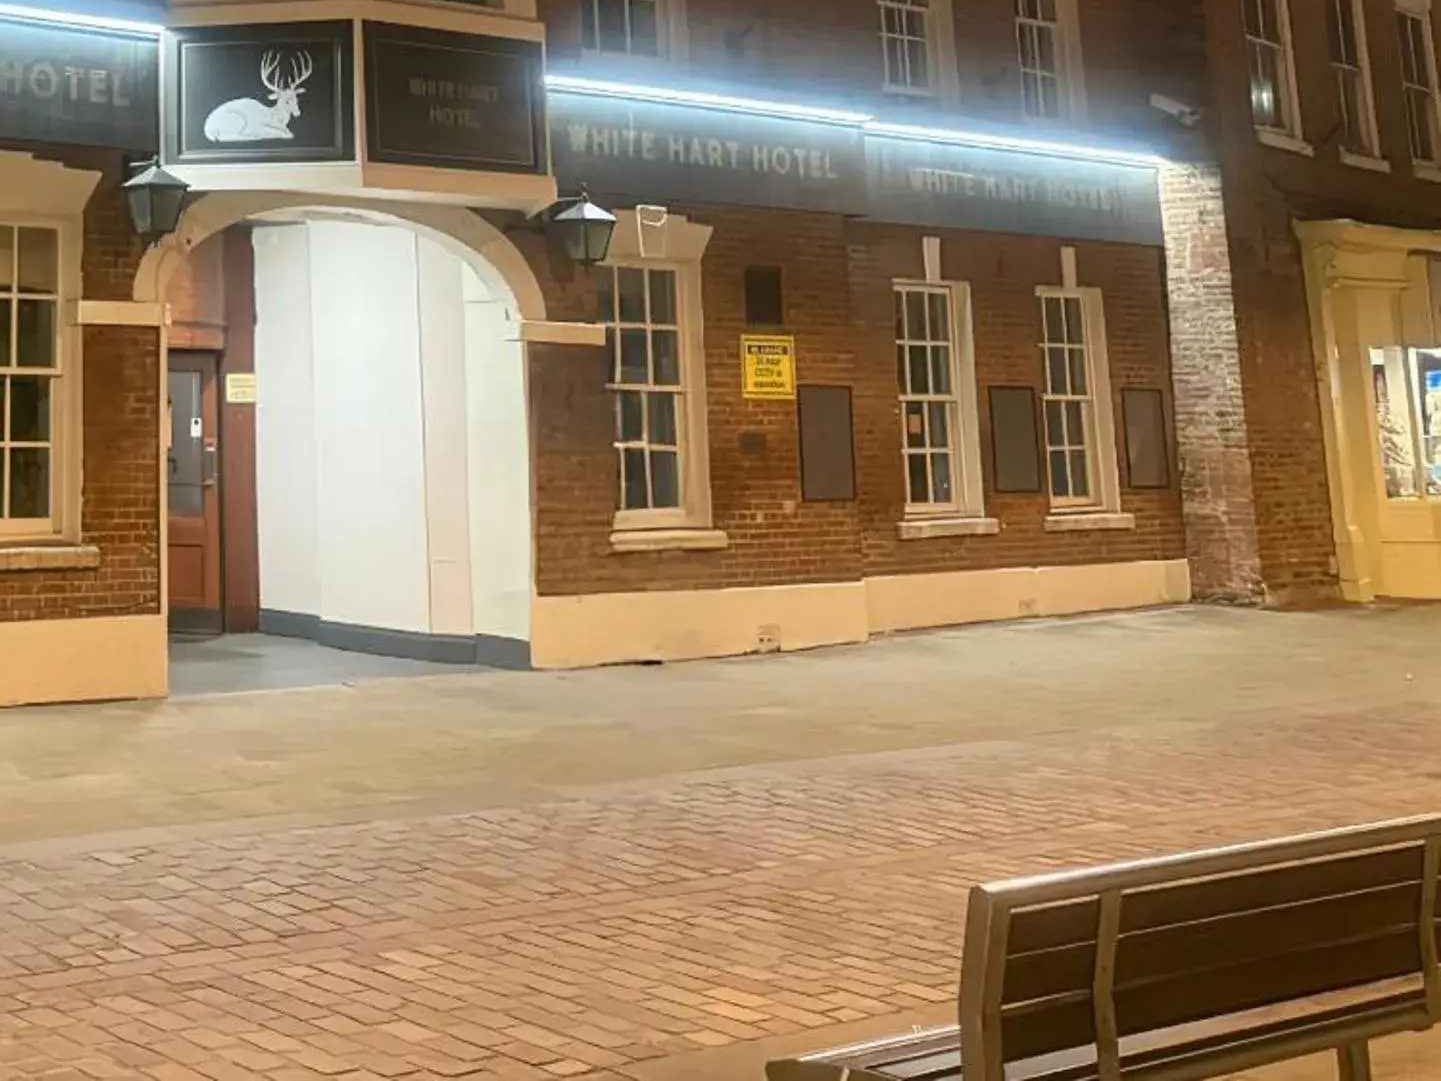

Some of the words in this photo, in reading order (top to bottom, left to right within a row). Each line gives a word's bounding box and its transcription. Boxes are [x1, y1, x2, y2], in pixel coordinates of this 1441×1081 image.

[0, 61, 130, 106] HOTEL
[567, 123, 655, 160] WHITE
[670, 137, 739, 170] HART
[752, 146, 839, 180] HOTEL
